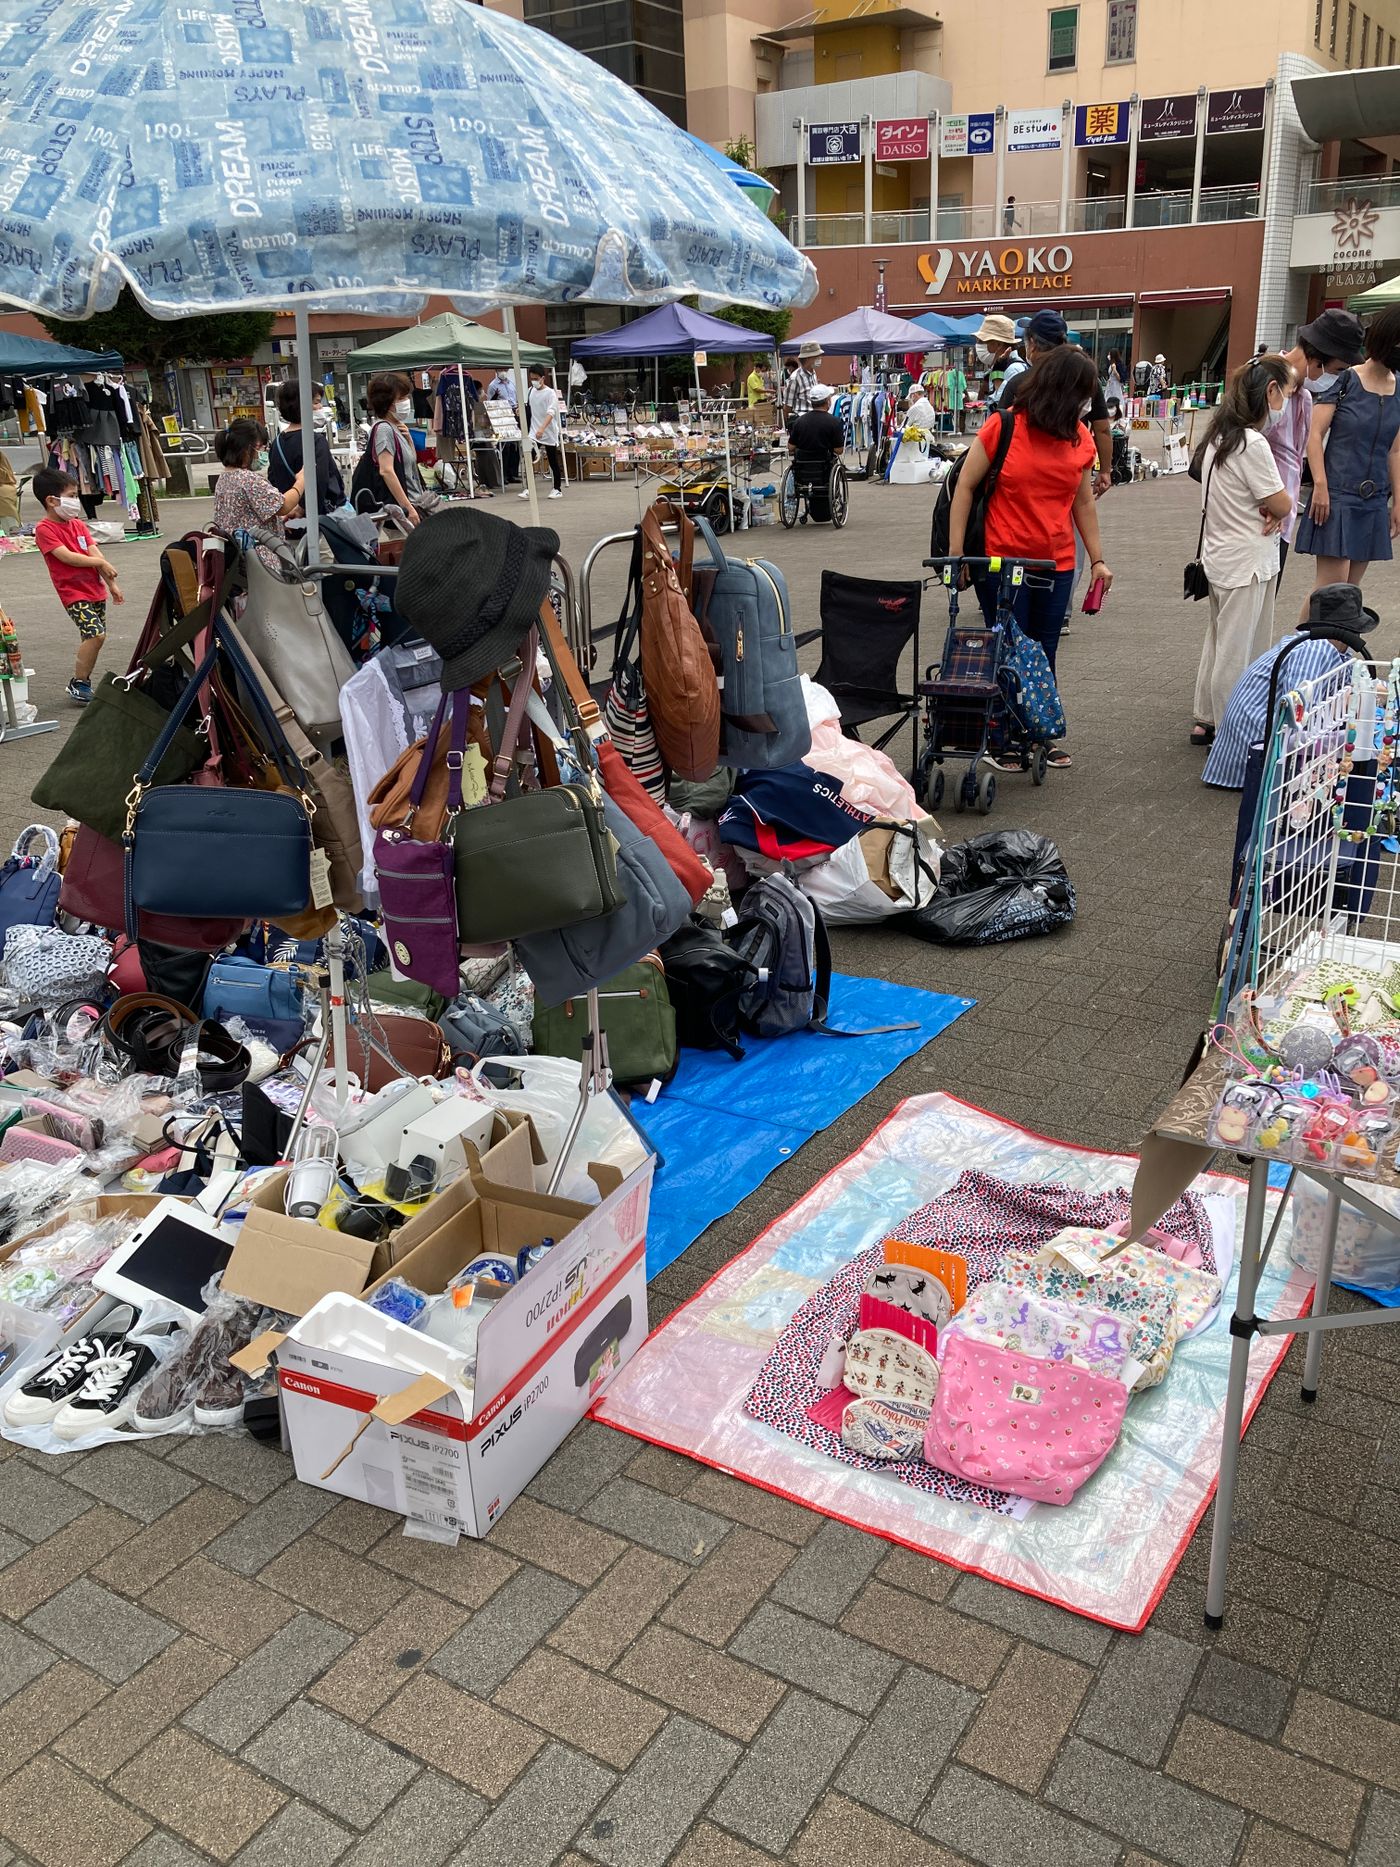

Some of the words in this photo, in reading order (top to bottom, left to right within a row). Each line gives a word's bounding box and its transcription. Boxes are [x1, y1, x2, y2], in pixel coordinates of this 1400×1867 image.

[177, 8, 206, 21] LIFE
[211, 13, 243, 66] MUSIC
[235, 85, 305, 102] PLAYS
[840, 124, 858, 134] 大吉
[1013, 125, 1024, 134] BE
[1026, 123, 1057, 133] studio
[1090, 106, 1115, 134] 薬
[405, 117, 443, 165] STOP
[880, 125, 924, 140] ダイソー
[37, 122, 77, 175] STOP
[353, 143, 385, 156] LIFE
[883, 143, 922, 155] DAISO
[215, 121, 263, 218] DREAM
[261, 162, 295, 171] MUSIC
[387, 148, 420, 204] MUSIC
[517, 124, 570, 227] DREAM
[411, 233, 481, 260] PLAYS
[1333, 249, 1372, 259] cocone
[525, 230, 540, 286] NATURAL
[957, 245, 1073, 277] YAOKO
[1319, 260, 1383, 273] SHOPPING
[957, 275, 1072, 293] MARKETPLACE
[1326, 272, 1376, 287] PLAZA
[812, 783, 871, 823] ATHLETICS
[1014, 907, 1047, 923] CREATE
[996, 927, 1031, 941] CREATE
[526, 1281, 563, 1328] iP2700
[284, 1376, 321, 1394] Canon
[478, 1395, 507, 1427] Canon
[480, 1404, 522, 1458] PIXUS
[523, 1375, 550, 1412] iP2700
[390, 1431, 430, 1450] PIXUS
[432, 1444, 460, 1459] iP2700
